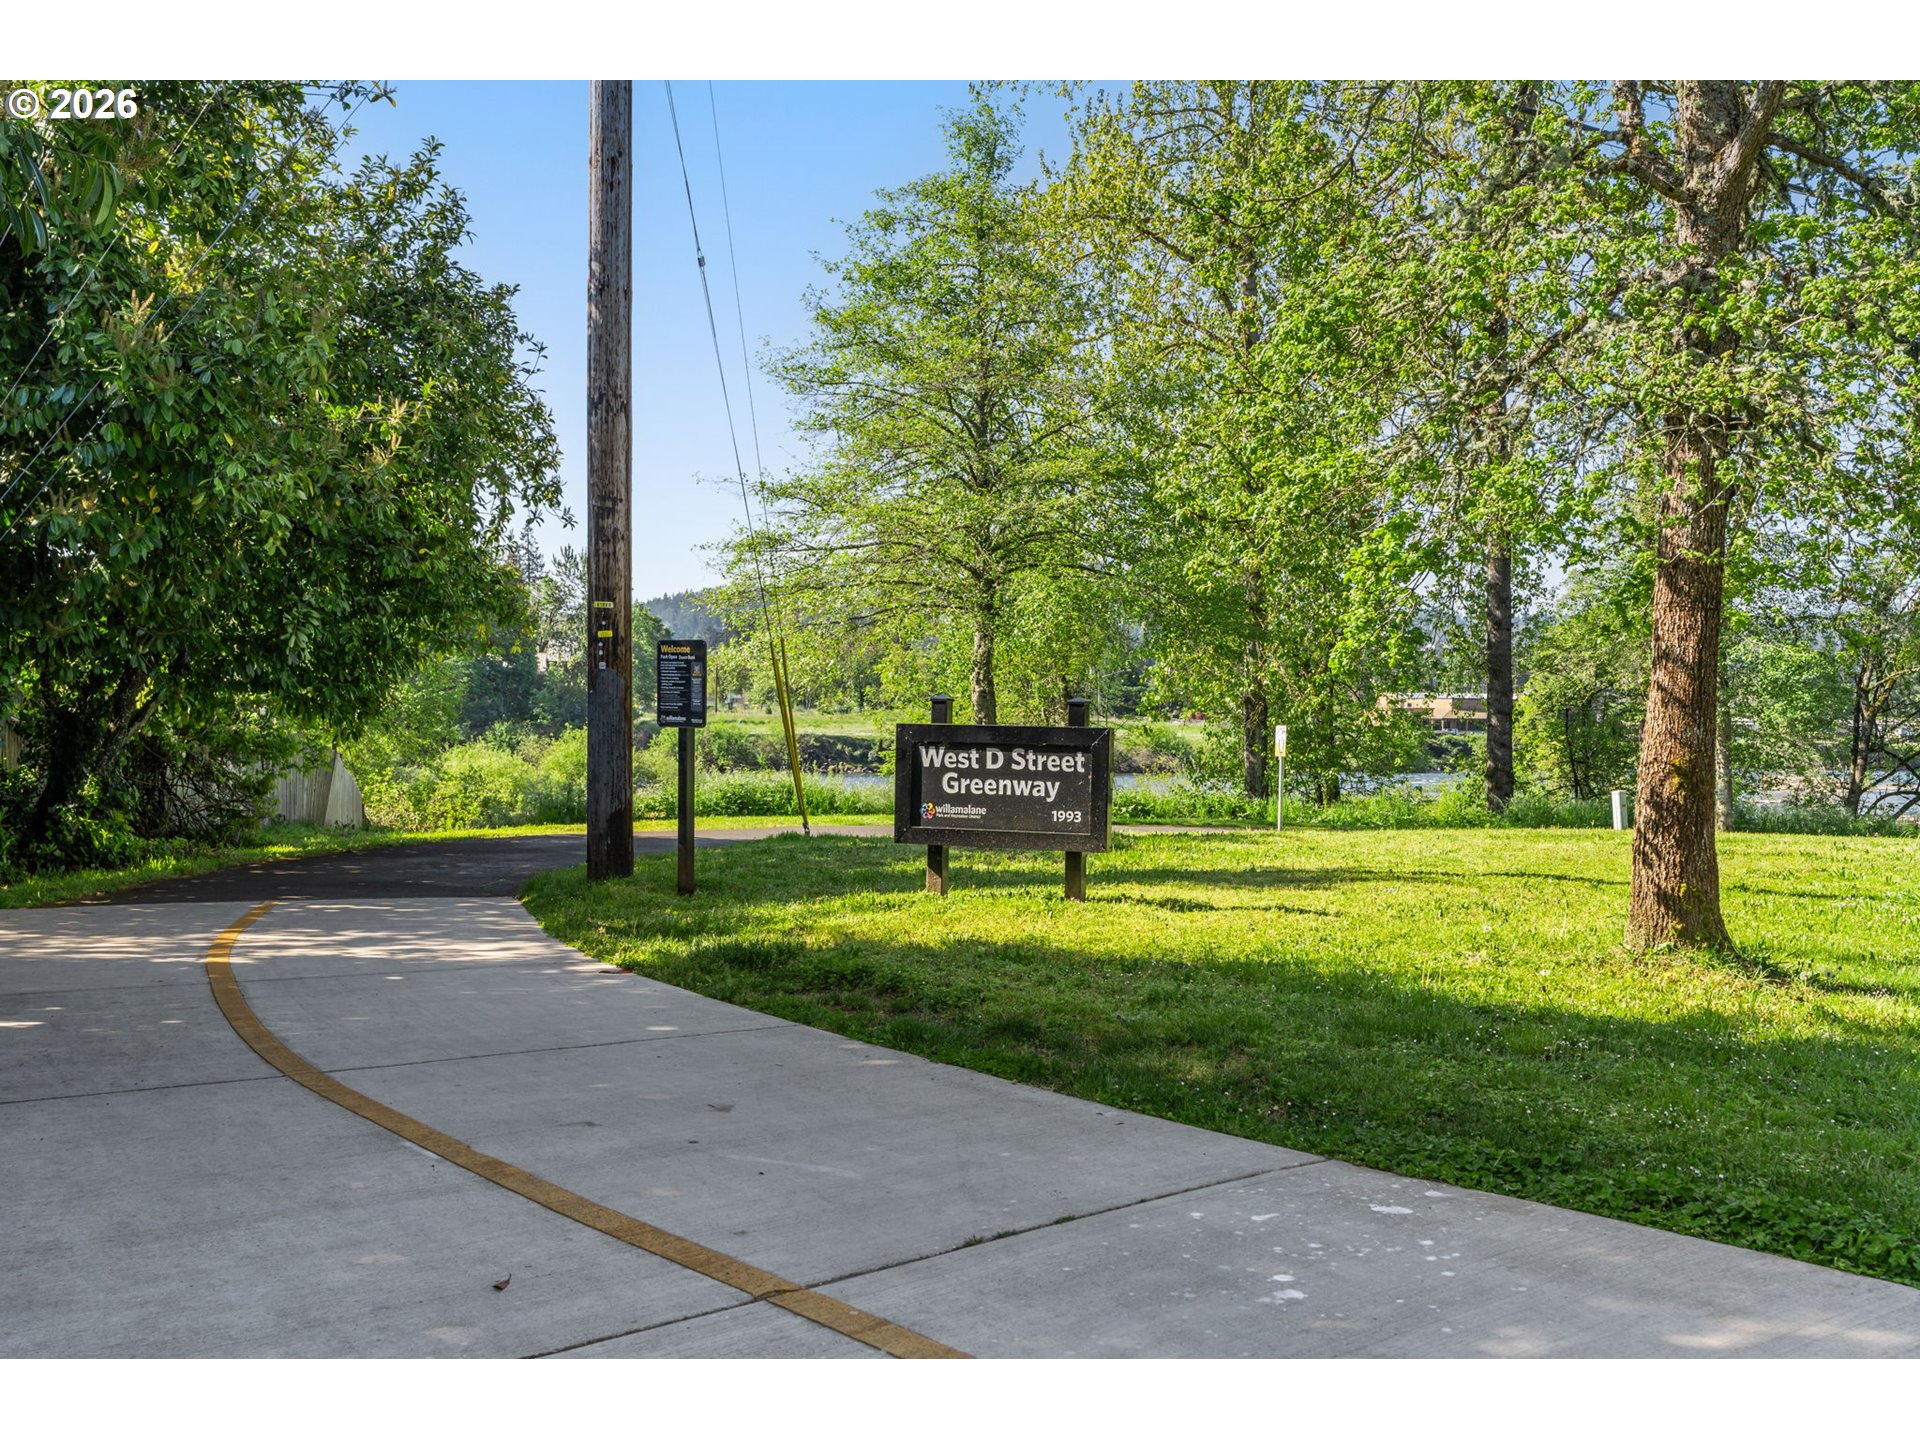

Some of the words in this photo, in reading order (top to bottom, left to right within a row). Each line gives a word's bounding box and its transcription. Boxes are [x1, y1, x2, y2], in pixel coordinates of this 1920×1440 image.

[660, 644, 691, 653] Welcome
[919, 746, 980, 769] West
[986, 748, 1004, 770] D
[1011, 748, 1085, 773] Street
[942, 772, 1061, 802] Greenway
[935, 803, 987, 815] willamalane
[1051, 810, 1082, 823] 1993
